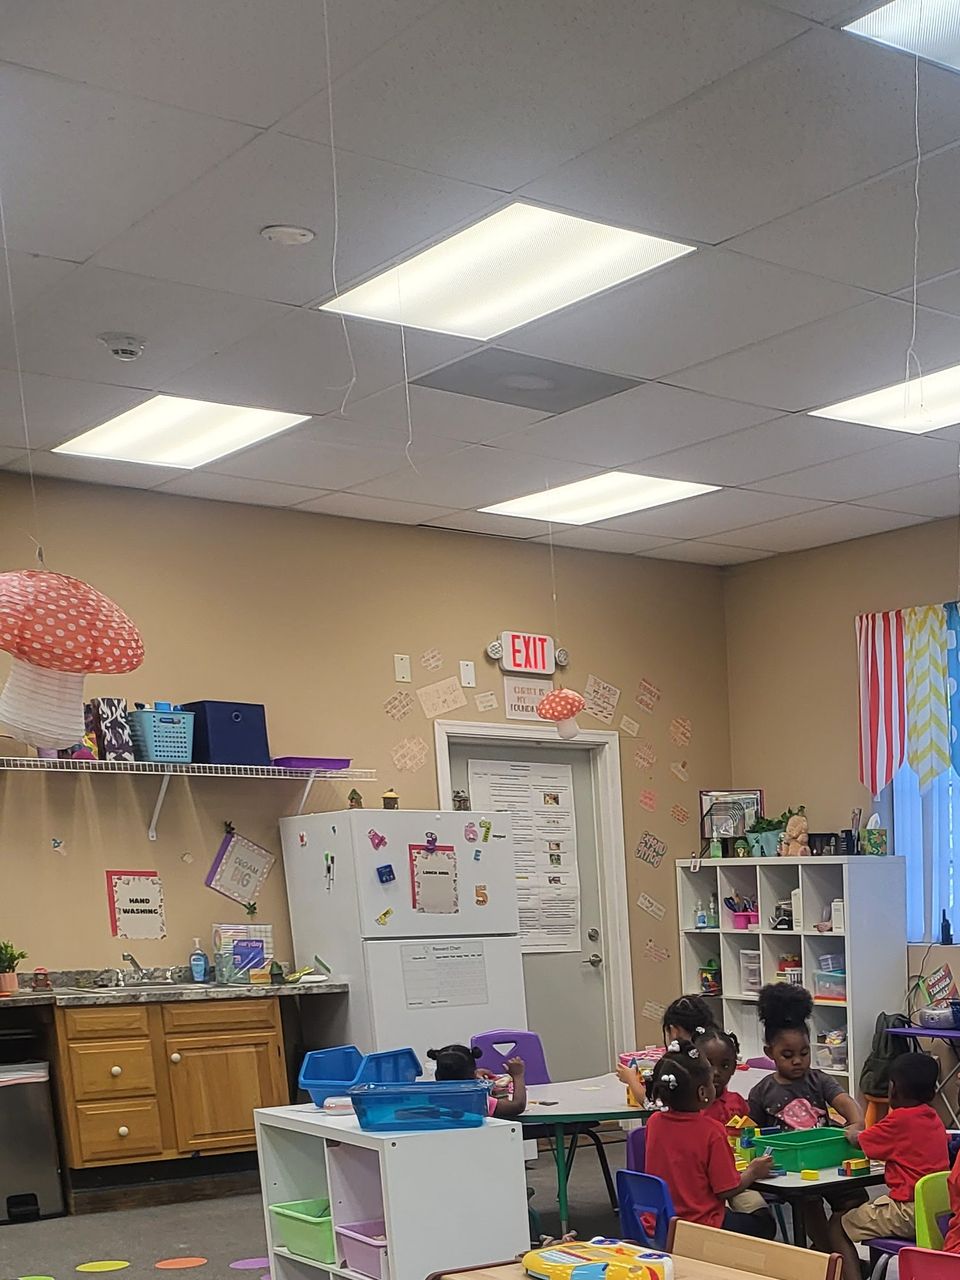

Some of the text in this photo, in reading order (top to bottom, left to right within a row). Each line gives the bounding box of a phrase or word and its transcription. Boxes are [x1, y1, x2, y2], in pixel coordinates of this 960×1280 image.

[511, 634, 547, 670] EXIT
[473, 849, 482, 862] E
[128, 897, 151, 905] HAND
[475, 885, 489, 906] 5
